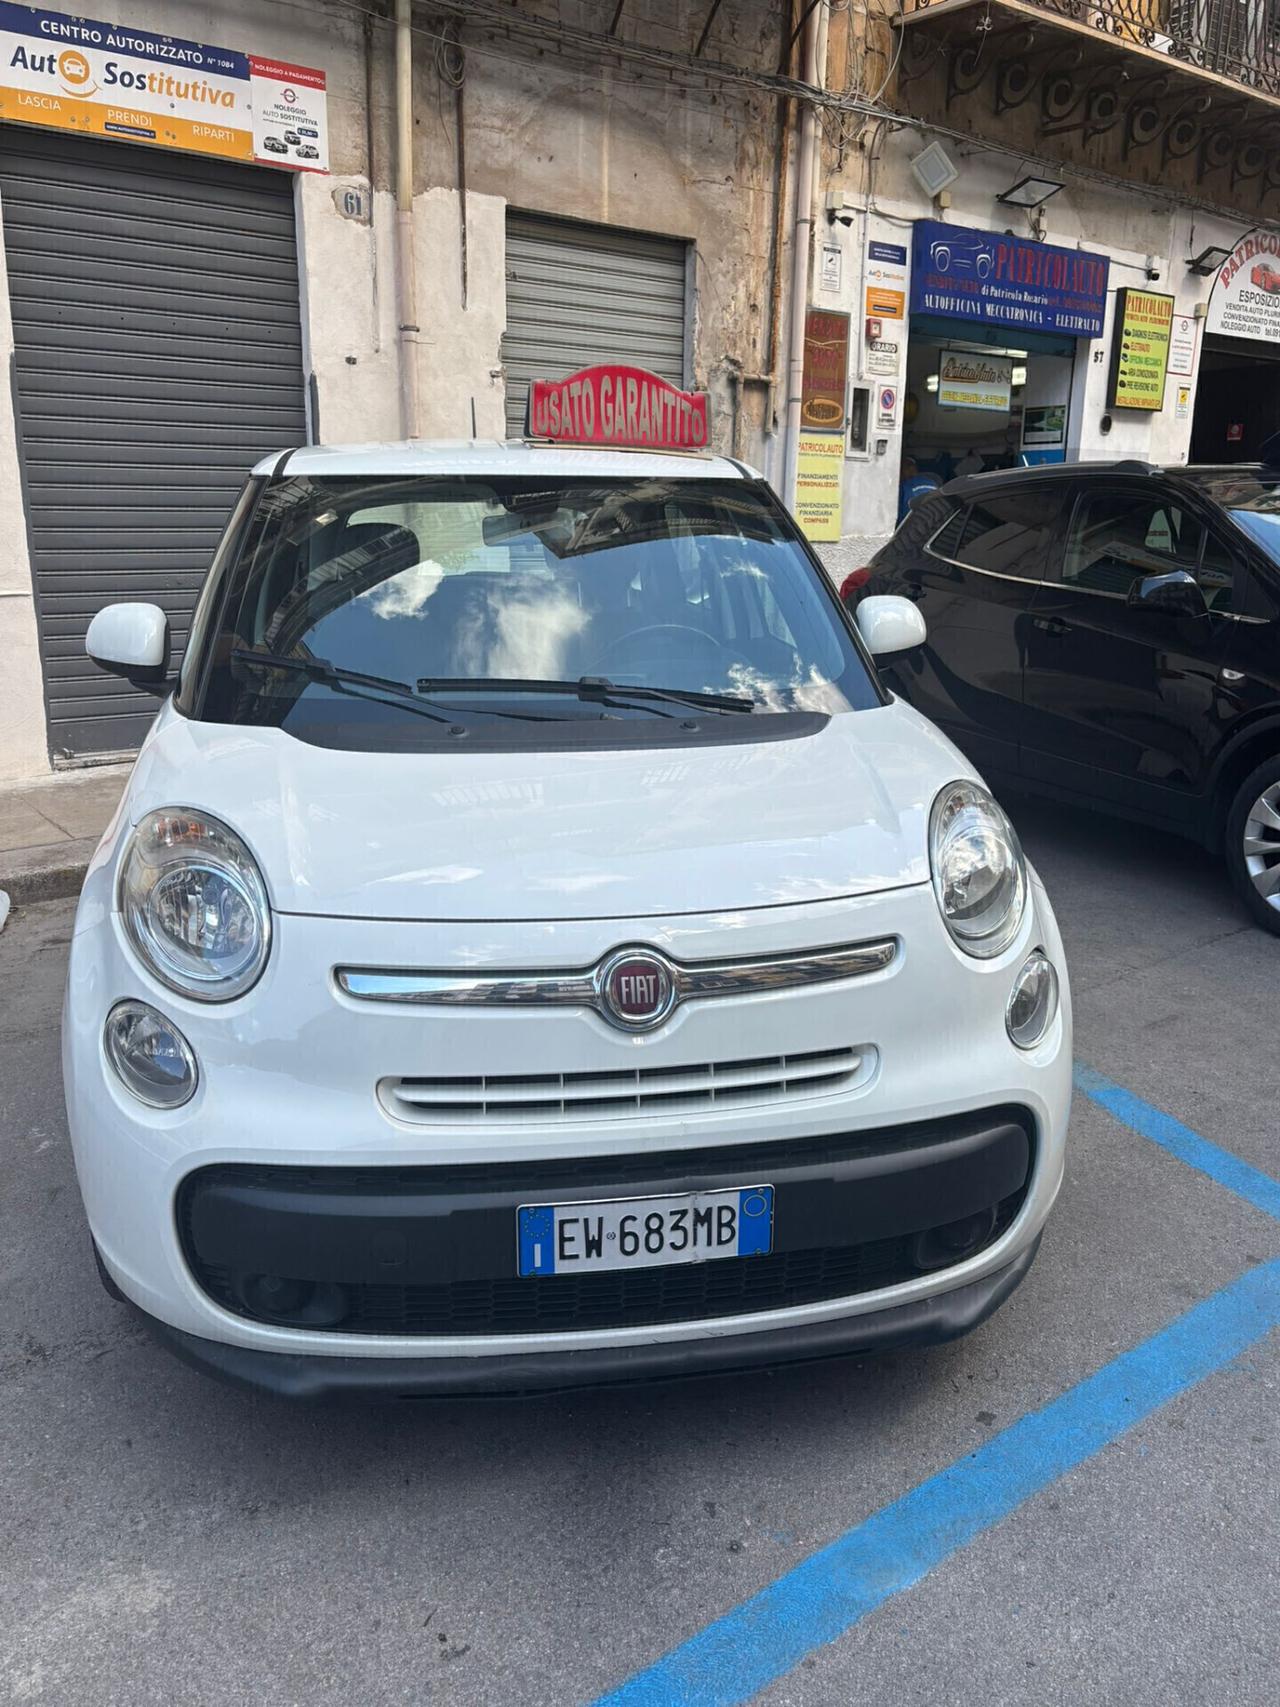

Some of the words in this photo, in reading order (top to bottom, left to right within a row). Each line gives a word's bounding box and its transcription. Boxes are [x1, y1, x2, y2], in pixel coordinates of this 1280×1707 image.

[41, 20, 102, 43] CENTRO
[106, 34, 203, 64] AUTORIZZATO
[217, 60, 235, 69] 1084
[255, 63, 283, 75] NOLEGGIO
[289, 71, 321, 84] PAGAMENTO
[104, 61, 235, 109] Sostitutiva
[18, 94, 61, 110] LASCIA
[274, 103, 307, 116] NOLEGGIO
[107, 109, 153, 127] PRENDI
[263, 110, 279, 119] AUTO
[280, 112, 318, 126] SOSTITUTIVA
[192, 125, 235, 142] RIPARTI
[344, 191, 362, 216] 61
[995, 242, 1105, 297] PATRICOLAUTO
[1220, 233, 1280, 290] PATRICO
[1239, 290, 1280, 308] ESPOSIZIO
[925, 294, 981, 315] AUTOFFICINA
[985, 303, 1043, 324] MECCATRONICA
[1225, 302, 1248, 313] VENDITA
[1248, 306, 1264, 316] AUTO
[1220, 321, 1247, 332] NOLEGGIO
[1247, 325, 1261, 334] AUTO
[1223, 312, 1268, 326] CONVENZIONATO
[871, 342, 898, 353] ORARIO
[1094, 352, 1104, 363] 57
[536, 377, 595, 438] USATO
[600, 375, 704, 445] GARANTITO
[620, 974, 656, 1005] FIAT
[558, 1216, 604, 1260] EW
